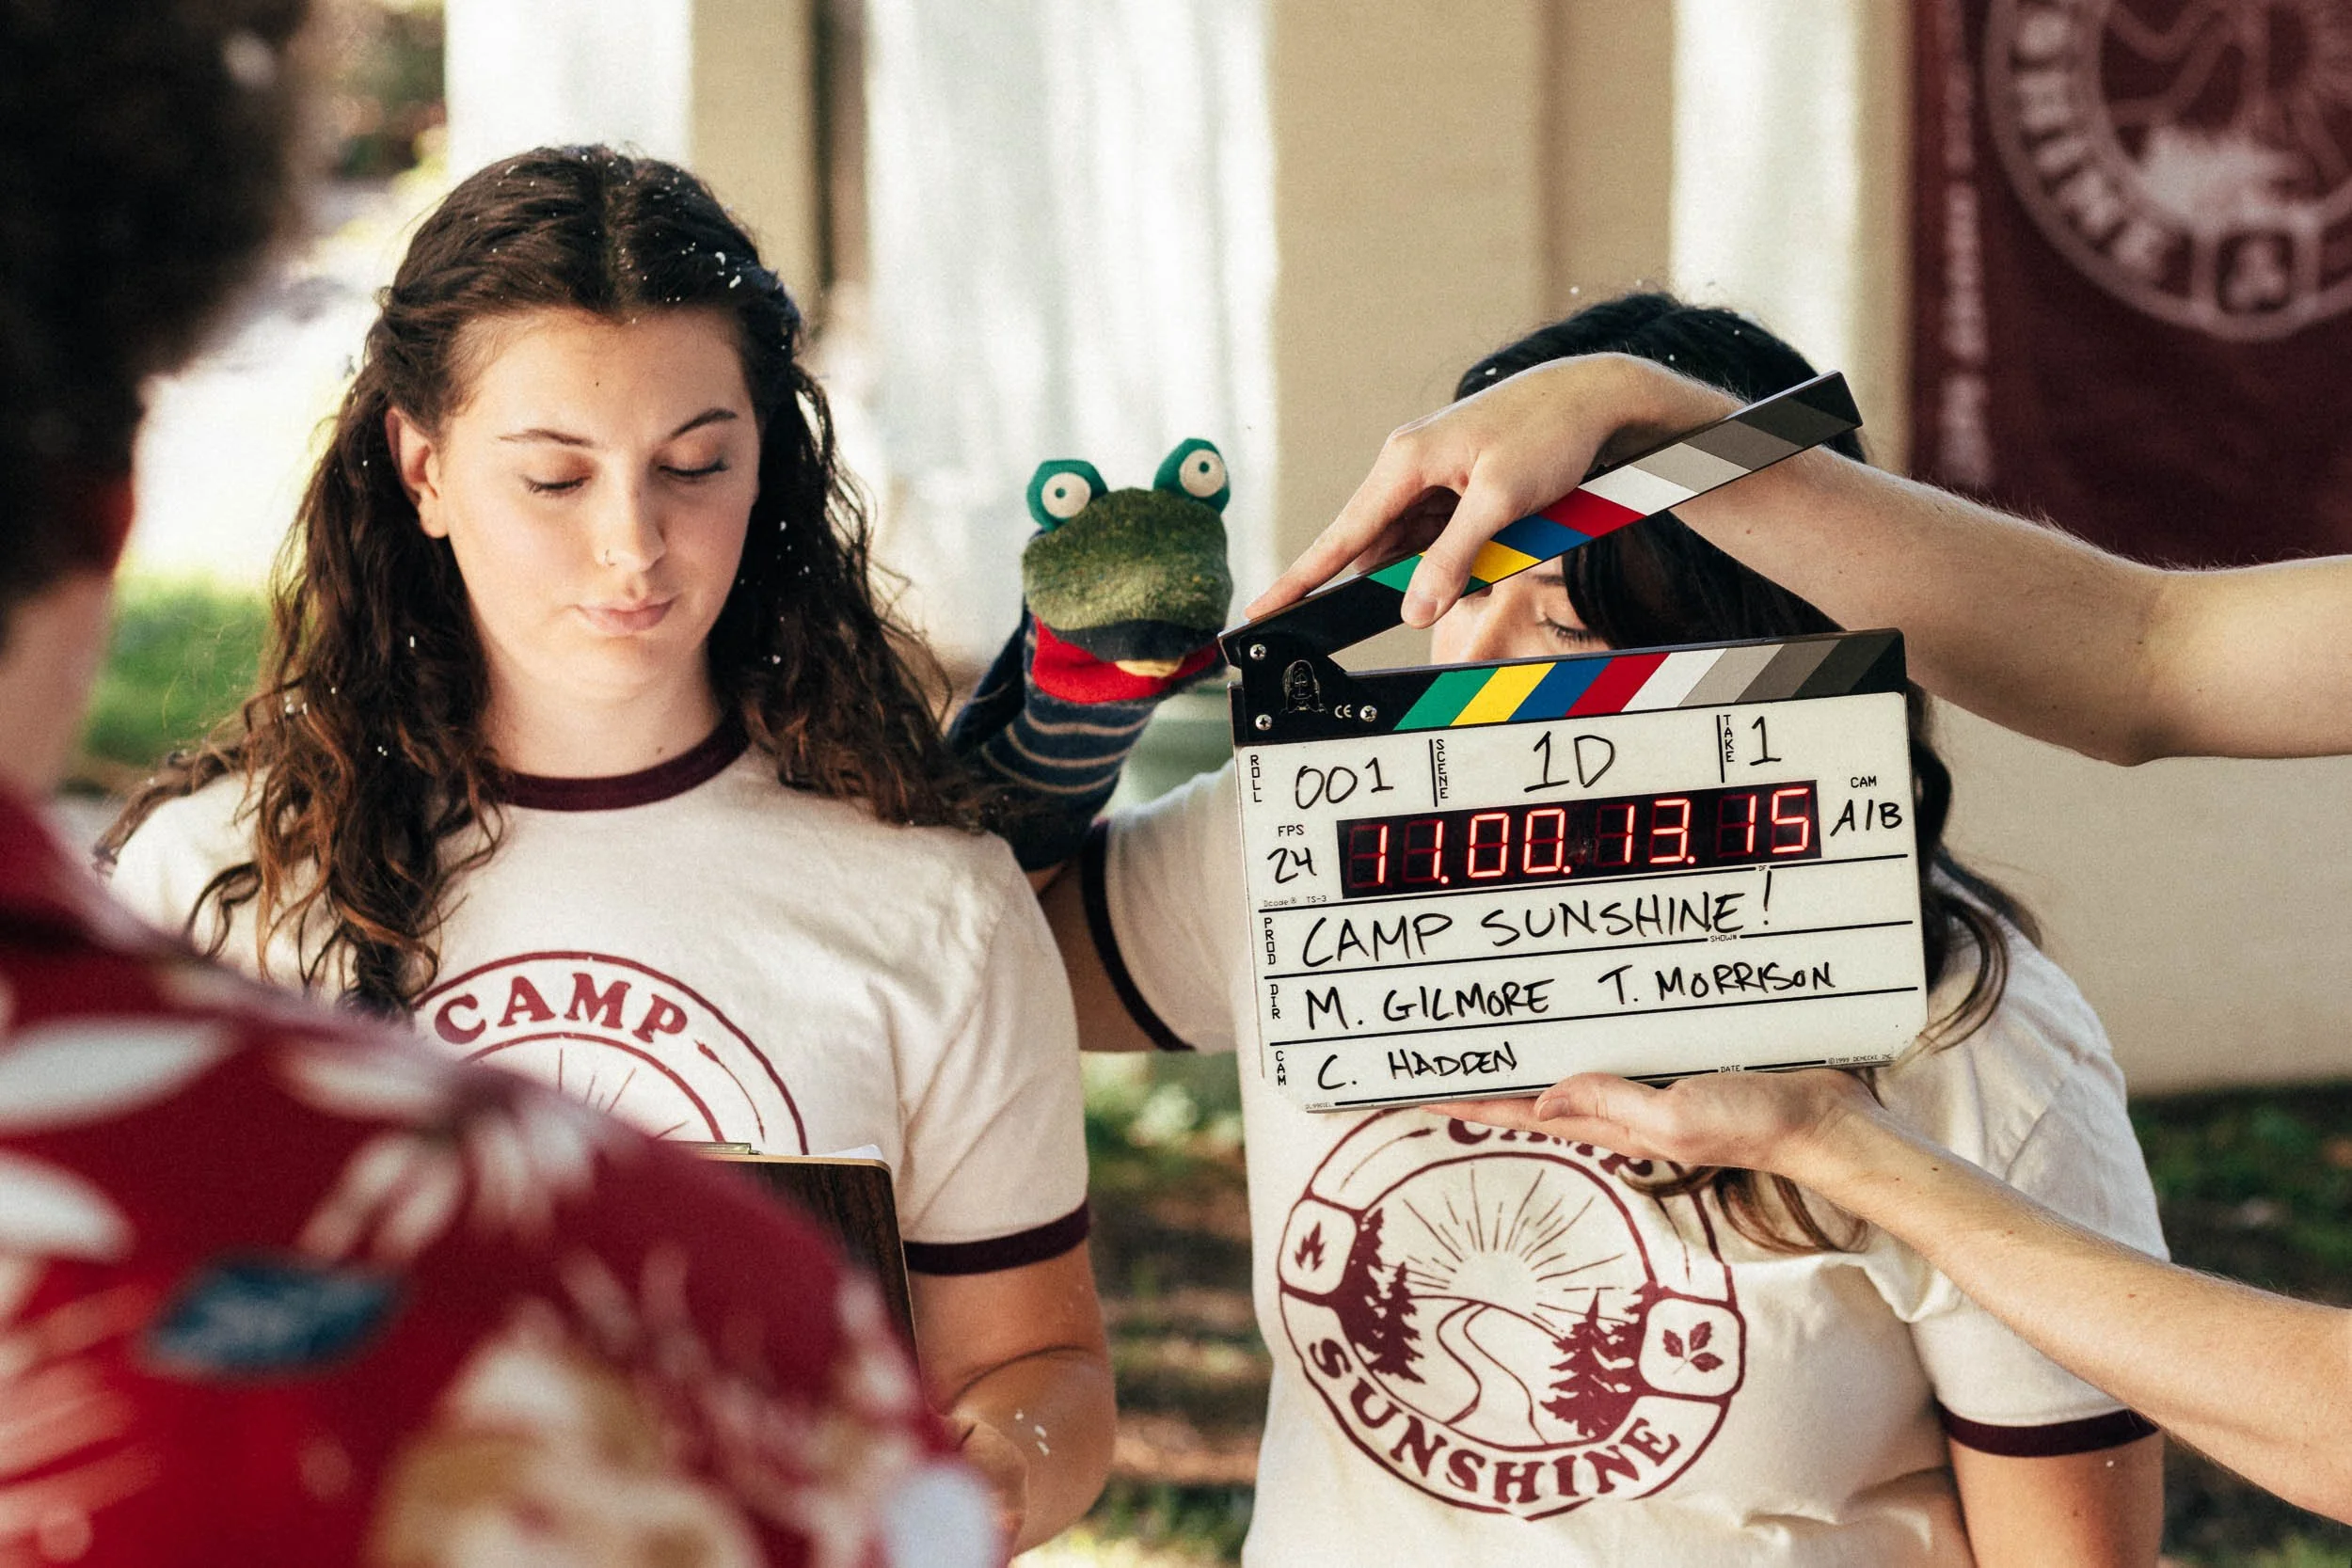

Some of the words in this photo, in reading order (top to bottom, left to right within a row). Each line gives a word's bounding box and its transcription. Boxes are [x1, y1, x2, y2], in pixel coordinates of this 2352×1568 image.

[1334, 704, 1353, 719] CE
[1523, 730, 1616, 793] 1D
[1723, 714, 1735, 763] TAKE
[1749, 715, 1782, 767] 1
[1249, 754, 1263, 803] ROLL
[1295, 756, 1394, 810] 001
[1436, 738, 1449, 800] SCENE
[1850, 775, 1878, 788] CAM
[1278, 823, 1305, 837] FPS
[1266, 846, 1318, 885] 24
[1301, 911, 1454, 968] CAMP
[1480, 869, 1772, 947] SUNSHINE!
[1306, 895, 1327, 904] TS-3
[1263, 917, 1277, 966] PROD
[434, 972, 689, 1044] CAMP
[1270, 984, 1281, 1021] DIR
[1305, 986, 1364, 1031] M.
[1383, 978, 1556, 1022] GILMORE
[1597, 964, 1640, 1006] T.
[1655, 961, 1836, 1002] MORRISON
[1275, 1050, 1287, 1087] CAM
[1317, 1053, 1358, 1090] C.
[1387, 1040, 1518, 1081] HADDEN
[1720, 1064, 1740, 1073] DATE
[1308, 1337, 1681, 1505] SUNSHINE
